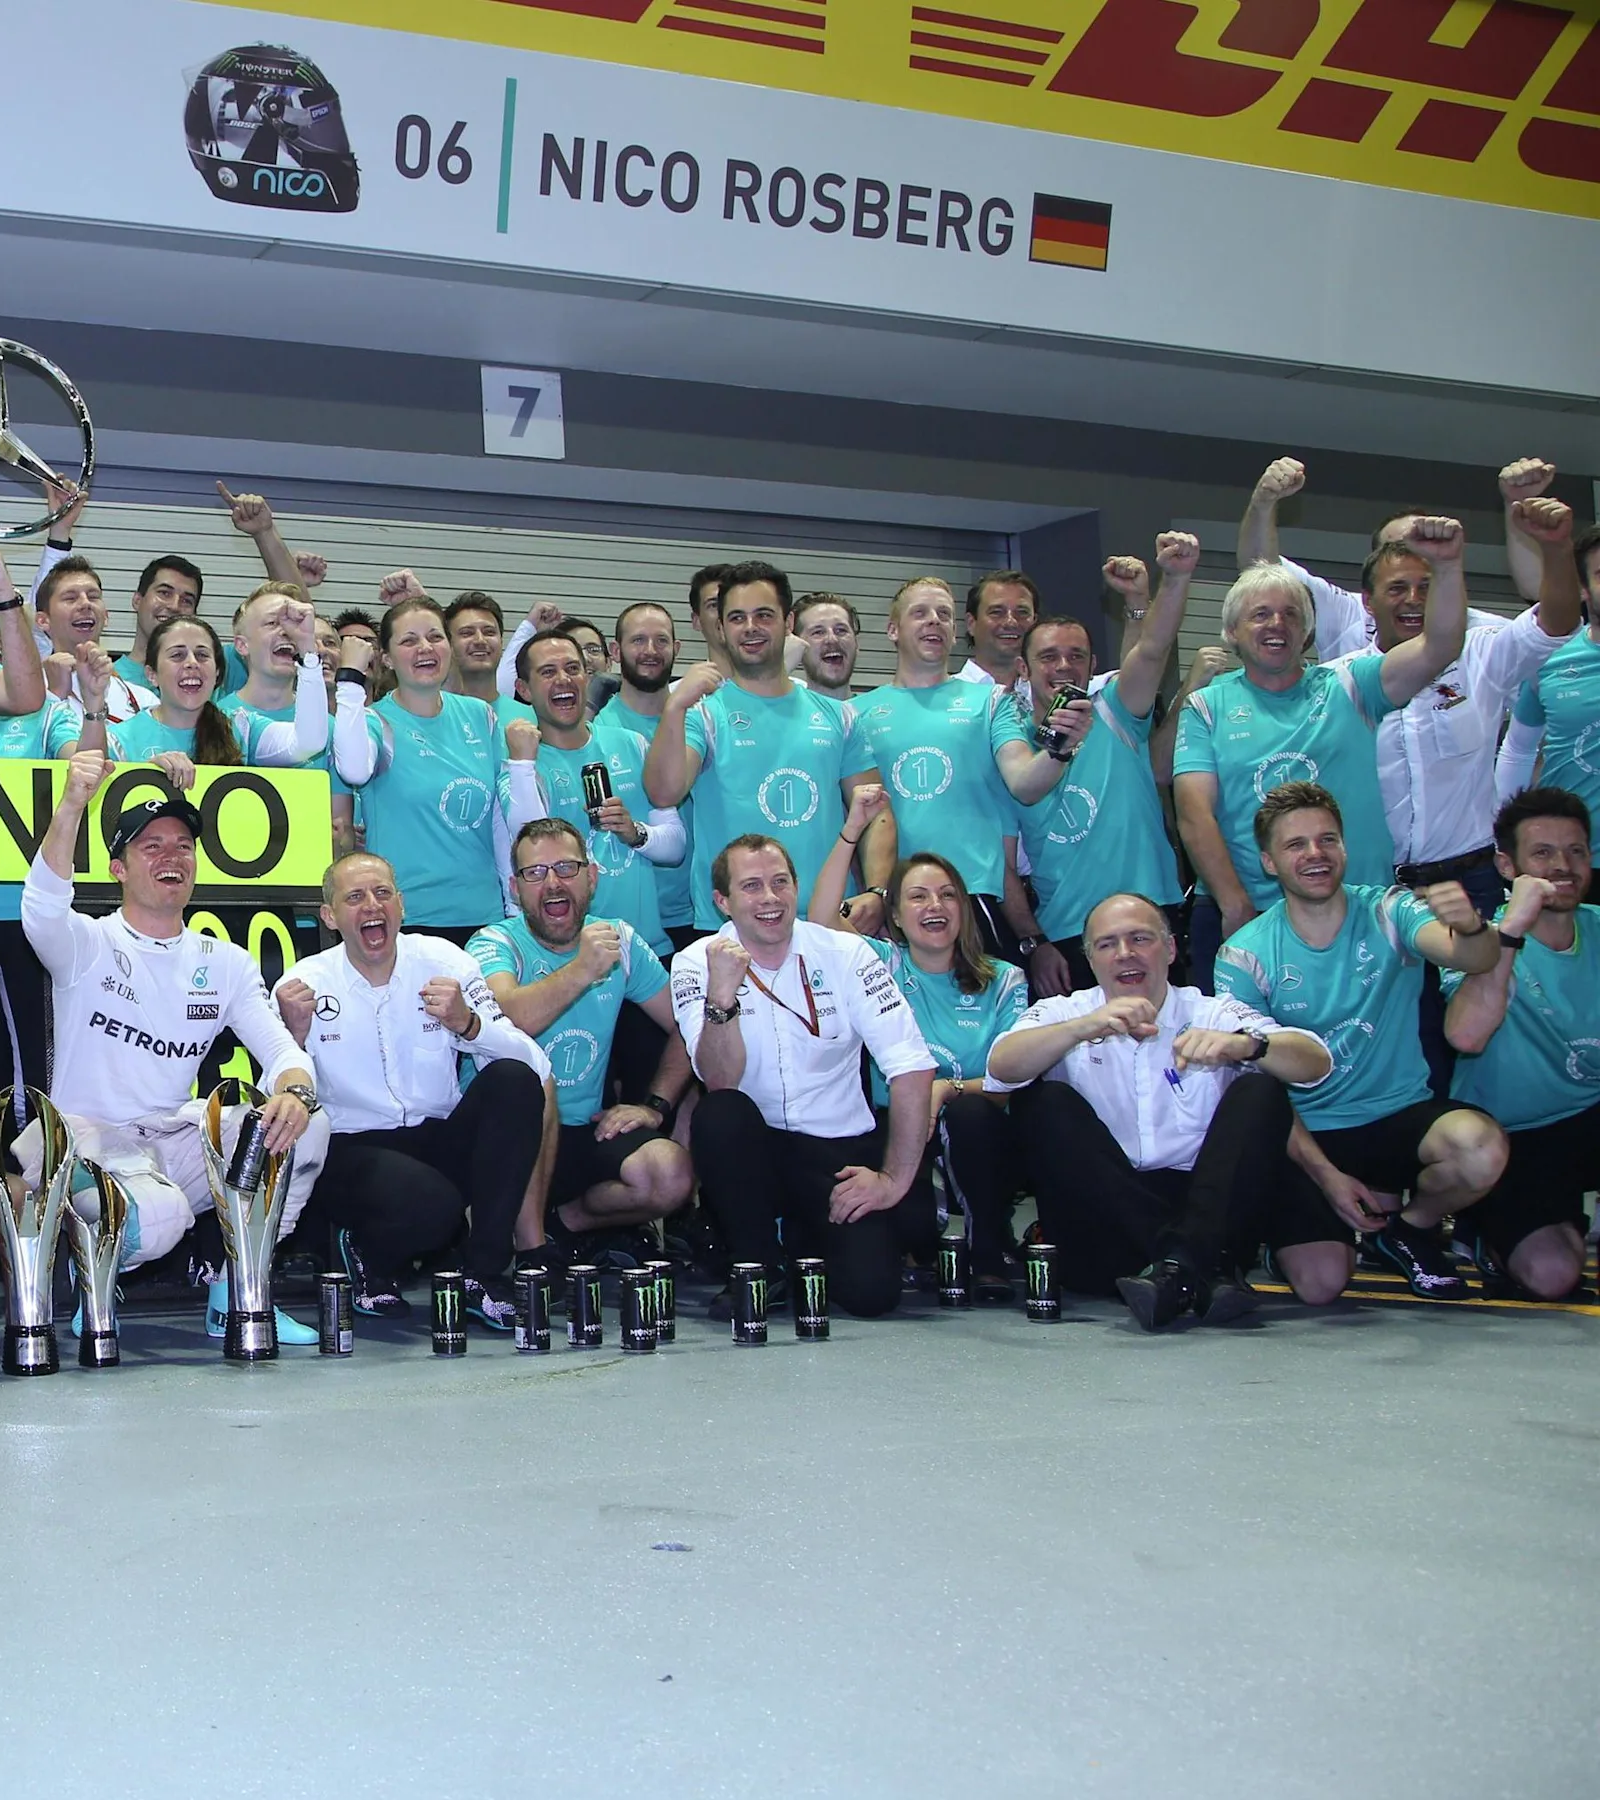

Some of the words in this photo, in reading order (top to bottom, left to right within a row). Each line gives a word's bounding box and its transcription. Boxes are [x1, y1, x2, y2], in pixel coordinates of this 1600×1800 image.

[395, 114, 474, 184] 06
[539, 133, 700, 213] NICO
[723, 158, 1015, 256] ROSBERG
[508, 385, 542, 438] 7
[908, 745, 943, 757] WINNERS
[1269, 752, 1307, 765] WINNERS
[765, 771, 776, 783] GP
[776, 768, 811, 782] WINNERS
[912, 757, 927, 788] 1
[454, 777, 486, 791] WINNERS
[779, 780, 793, 813] 1
[913, 793, 933, 801] 2016
[458, 788, 472, 820] 1
[778, 819, 800, 828] 2016
[1069, 830, 1088, 844] 2016
[603, 830, 620, 862] 1
[672, 978, 699, 989] EPSON
[863, 968, 888, 986] EPSON
[877, 990, 897, 1004] IWC
[188, 1005, 219, 1016] BOSS
[88, 1011, 210, 1058] PETRONAS
[326, 1033, 341, 1042] UBS
[562, 1029, 596, 1043] WINNERS
[562, 1040, 579, 1074] 1
[556, 1079, 576, 1087] 2016
[743, 1320, 768, 1330] MONS
[798, 1316, 829, 1324] MONSTE
[630, 1328, 656, 1337] MONST
